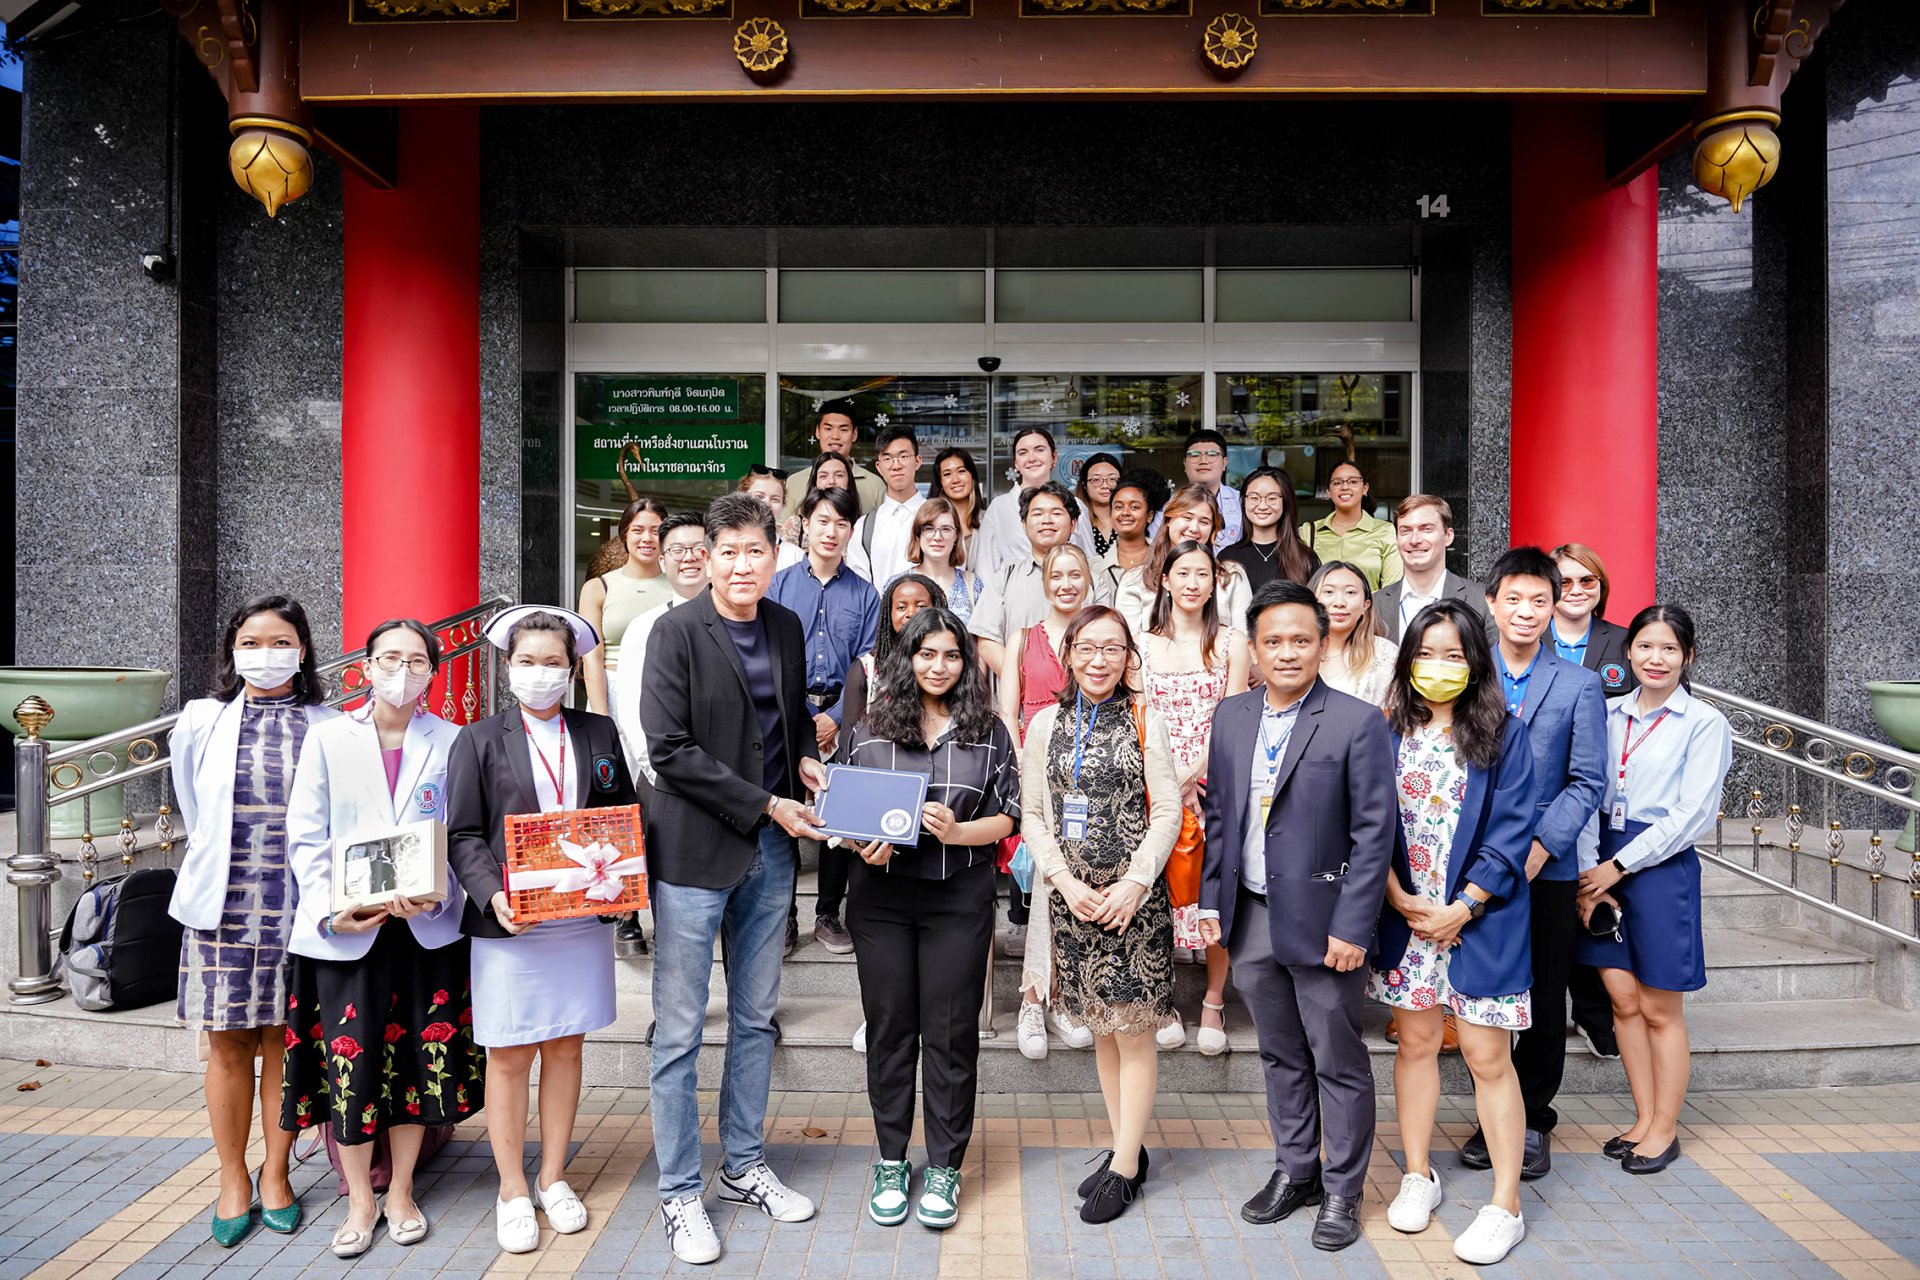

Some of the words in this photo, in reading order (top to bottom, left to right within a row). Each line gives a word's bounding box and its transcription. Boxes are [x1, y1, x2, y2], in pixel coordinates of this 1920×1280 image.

[1416, 194, 1451, 218] 14
[669, 404, 721, 413] 08.00-16.00
[724, 405, 733, 413] น.
[931, 434, 975, 445] Christmas
